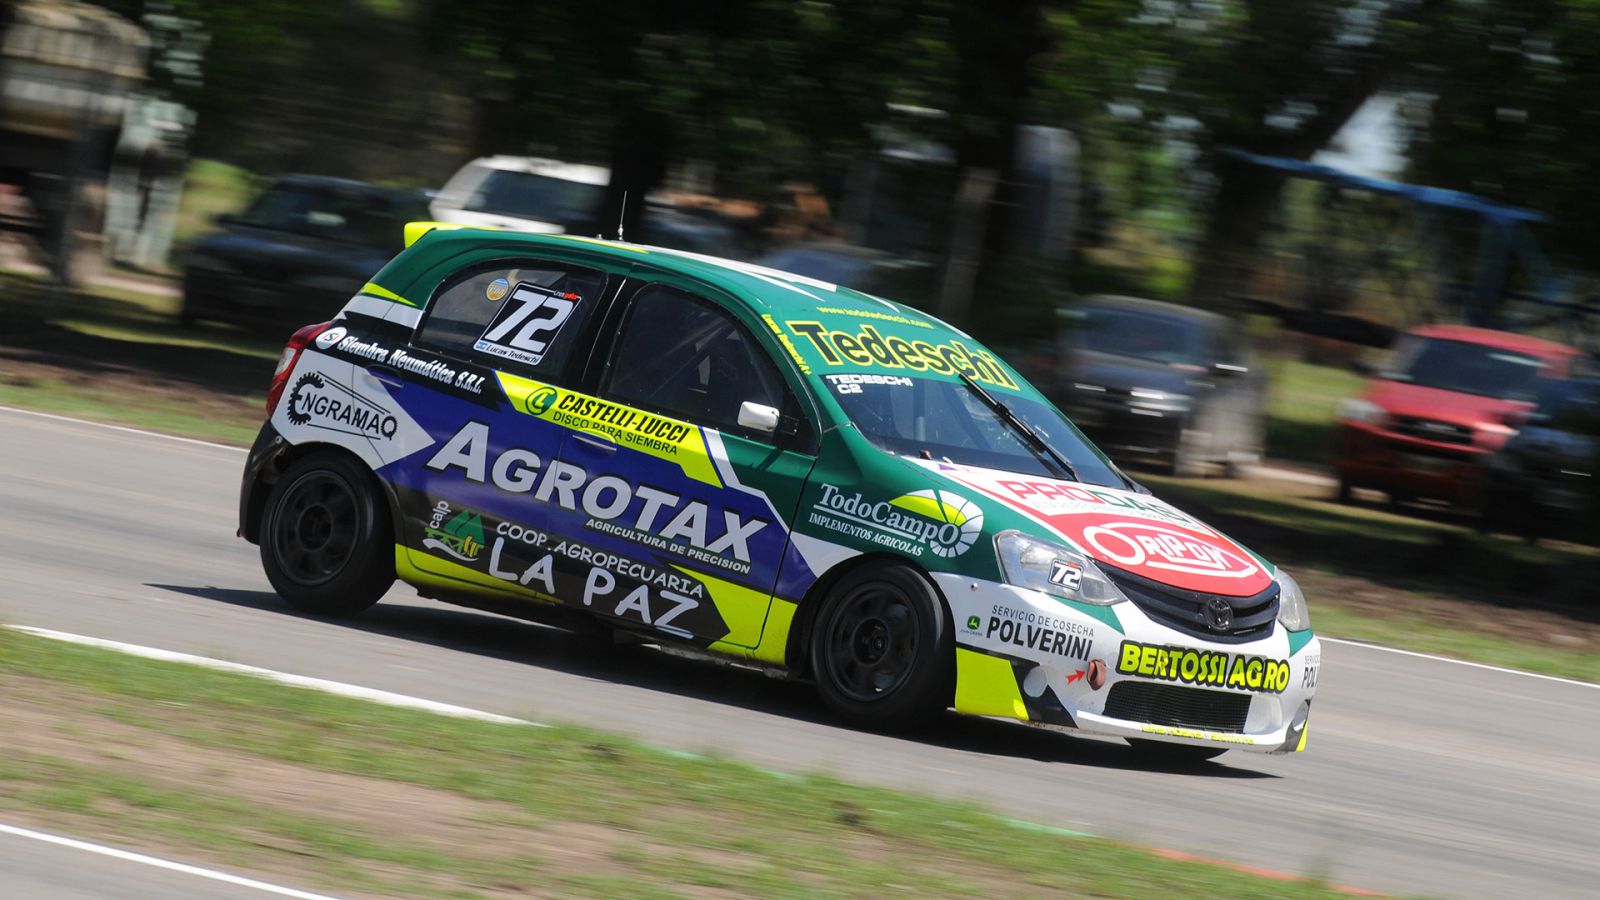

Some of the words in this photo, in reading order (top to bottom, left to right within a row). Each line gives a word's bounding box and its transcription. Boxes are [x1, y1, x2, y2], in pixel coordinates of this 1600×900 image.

[484, 288, 574, 353] 72
[337, 336, 388, 362] Siembra
[387, 349, 453, 385] Neumática
[486, 344, 507, 357] Lucas
[508, 349, 539, 364] Tedeschi
[785, 320, 1021, 391] Tedeschi
[825, 374, 913, 387] TEDESCHI
[836, 383, 863, 395] C2
[553, 410, 590, 429] DISCO
[592, 419, 624, 442] PARA
[625, 431, 678, 456] SIEMBRA
[558, 394, 691, 443] CASTELLI-LUCCI
[426, 420, 768, 563] AGROTAX
[429, 500, 452, 529] calp
[585, 518, 667, 547] AGRICULTURA
[669, 542, 686, 556] DE
[687, 547, 751, 575] PRECISION
[808, 512, 873, 541] IMPLEMENTOS
[871, 534, 924, 557] AGRICOLAS
[489, 537, 555, 594] LA
[583, 566, 699, 639] PAZ
[1052, 562, 1081, 588] 72
[986, 616, 1093, 661] POLVERINI
[991, 604, 1035, 623] SERVICIO
[1037, 614, 1050, 627] DE
[1052, 618, 1095, 637] COSECHA
[1118, 641, 1227, 683] BERTOSSI
[1229, 656, 1292, 692] AGRO
